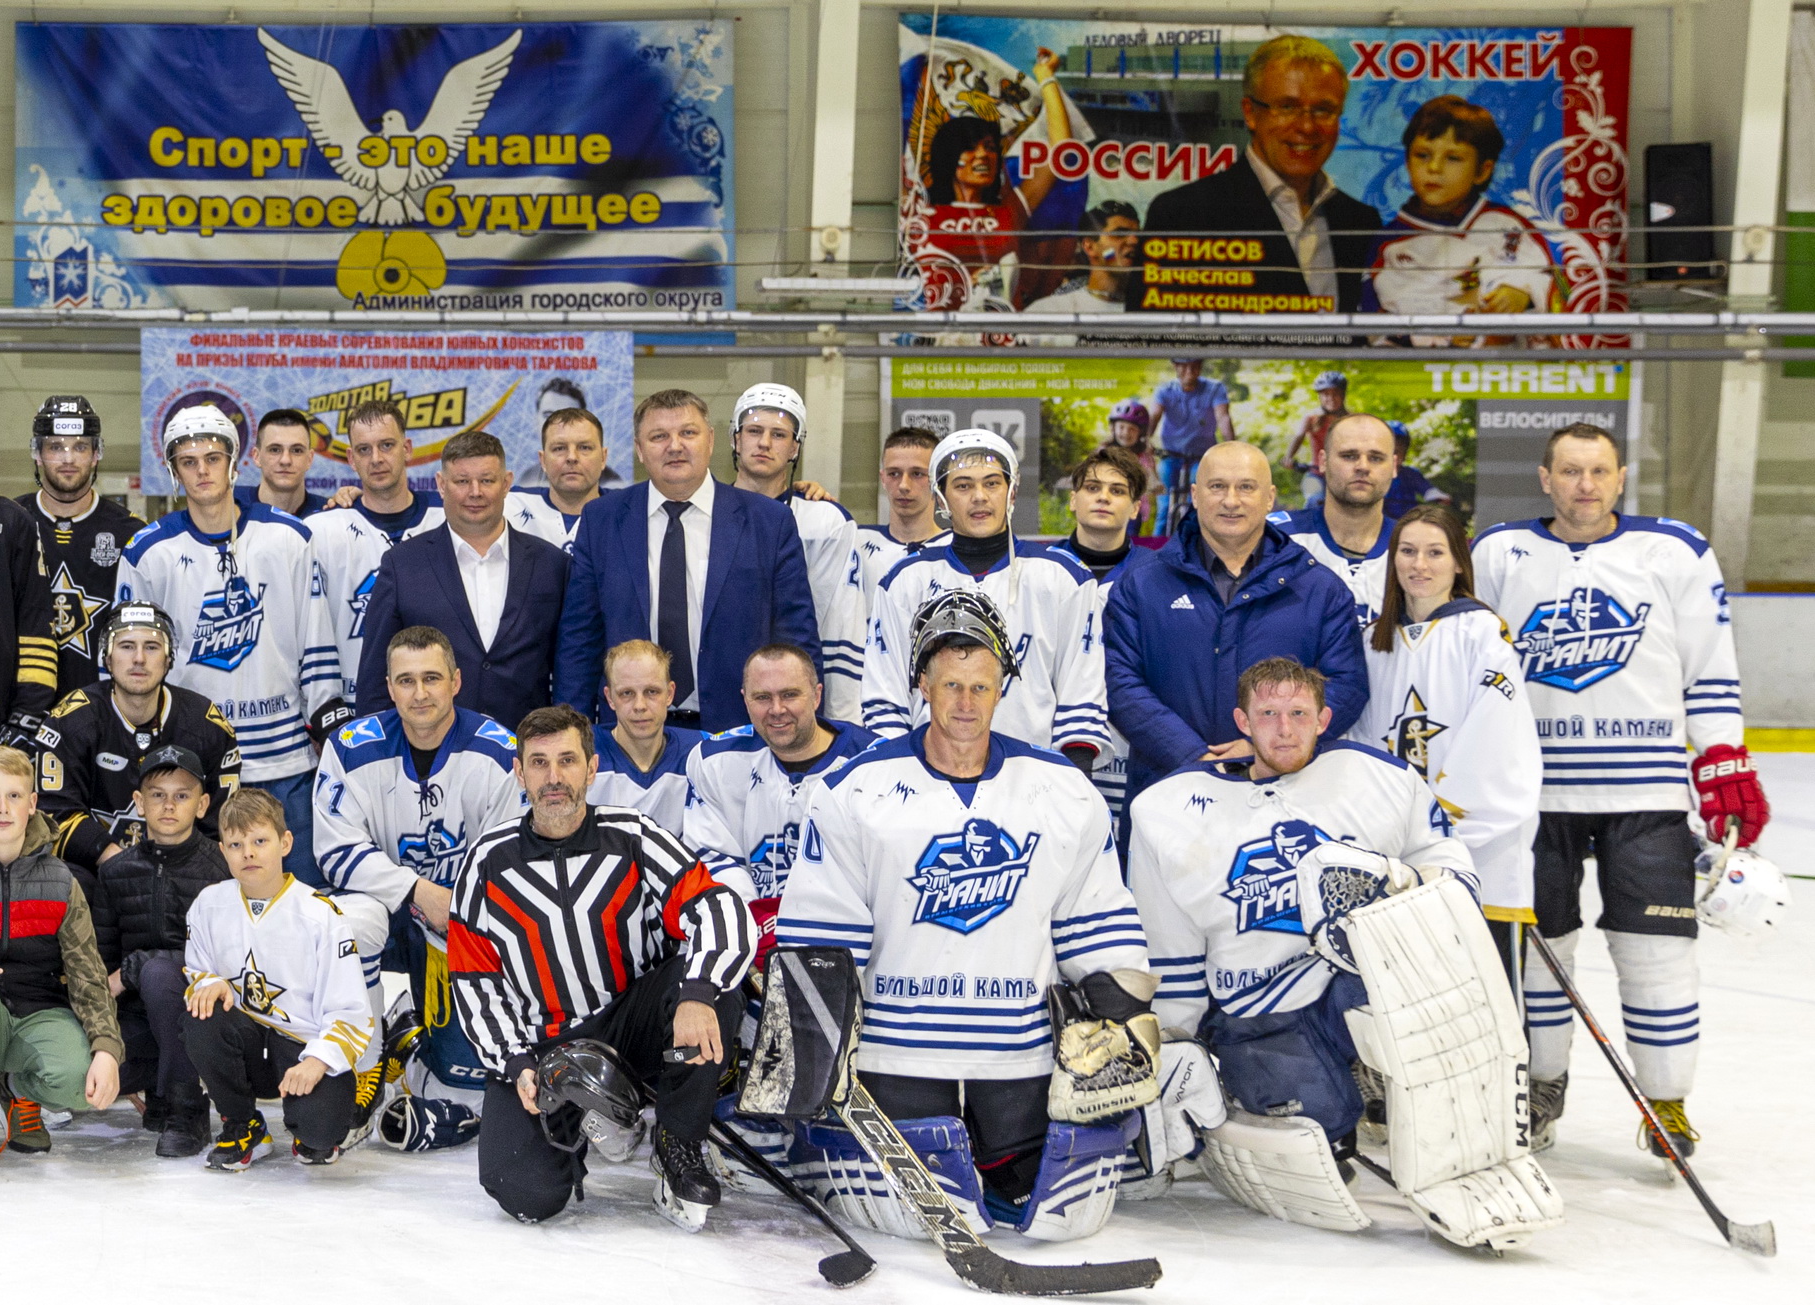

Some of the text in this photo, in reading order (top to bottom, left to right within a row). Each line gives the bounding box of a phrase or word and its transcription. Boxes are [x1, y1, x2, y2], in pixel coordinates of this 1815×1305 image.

[1084, 28, 1222, 48] ЛЕДОВЫЙ ДВОРЕЦ
[1347, 31, 1565, 81] ХОККЕЙ
[149, 126, 309, 175] Спорт
[358, 133, 449, 168] это
[466, 133, 612, 166] наше
[1019, 138, 1238, 181] РОССИИ
[101, 184, 662, 236] здоровое будущее
[940, 217, 1000, 234] СССР
[1143, 238, 1265, 263] ФЕТИСОВ
[1143, 265, 1255, 286] Вячеслав
[352, 290, 723, 312] Администрация городского округа
[1142, 291, 1335, 314] Александрович
[190, 333, 275, 348] ФИНАЛЬНЫЕ
[279, 333, 339, 349] КРАЕВЫЕ
[341, 334, 443, 350] СОРЕВНОВАНИЯ
[502, 336, 585, 351] ХОККЕИСТОВ
[176, 353, 598, 371] НА ПРИЗЫ КЛУБА имени АНАТОЛИЯ ВЛАДИМИРОВИЧА ТАРАСОВА
[902, 362, 1065, 375] ДЛЯ СЕБЯ Я ВЫБИРАЮ TORRENT
[902, 379, 925, 389] МОЯ
[927, 379, 976, 391] СВОБОДА
[978, 379, 1036, 391] ДВИЖЕНИЯ
[1046, 377, 1070, 389] МОЙ
[1073, 379, 1117, 390] TORRENT
[1424, 363, 1617, 394] TORRENT
[59, 402, 78, 413] 28
[55, 422, 83, 431] согаз
[1171, 602, 1195, 610] adidas
[194, 612, 263, 657] ГРАНИТ
[1523, 633, 1640, 680] ГРАНИТ
[239, 694, 291, 721] КАМЕНЬ
[8, 712, 42, 729] CC
[1538, 714, 1585, 738] ШОЙ
[101, 756, 119, 765] МИР
[915, 867, 1027, 921] ГРАНИТ
[1239, 879, 1302, 931] ГРА
[449, 1064, 488, 1079] CC
[1514, 1063, 1530, 1147] CCM
